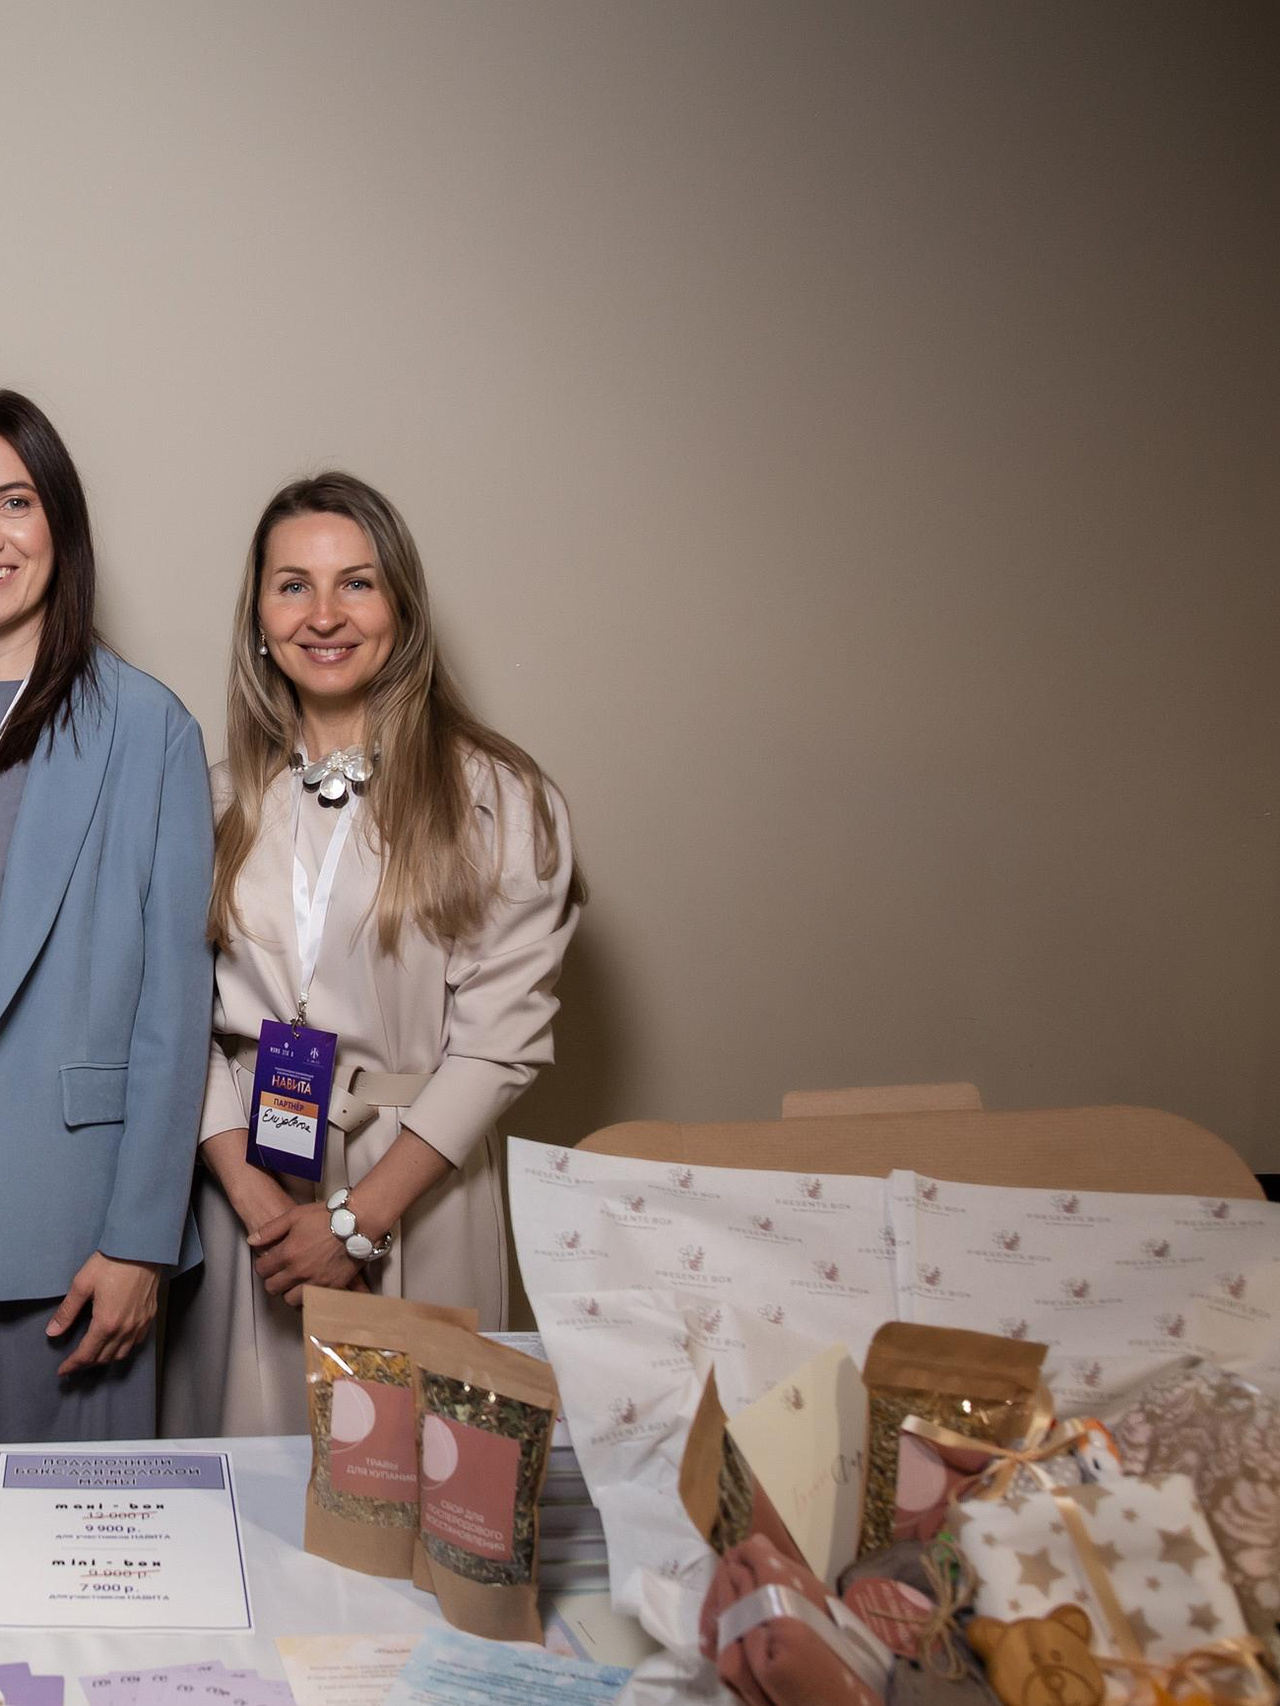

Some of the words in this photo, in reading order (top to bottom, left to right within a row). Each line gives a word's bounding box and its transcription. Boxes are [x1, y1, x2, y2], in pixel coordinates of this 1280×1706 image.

[272, 1074, 312, 1096] НАВИТА
[14, 1467, 64, 1476] БОКС
[68, 1468, 105, 1477] ДЛЯ
[108, 1467, 201, 1476] МОЛОДОЙ
[346, 1464, 368, 1477] ДЛЯ
[78, 1477, 138, 1486] МАМЫ
[129, 1502, 165, 1510] box
[85, 1524, 94, 1532] 9
[97, 1524, 124, 1533] 900
[52, 1558, 96, 1566] mini
[124, 1559, 161, 1567] box
[80, 1583, 89, 1591] 7
[92, 1583, 121, 1592] 900
